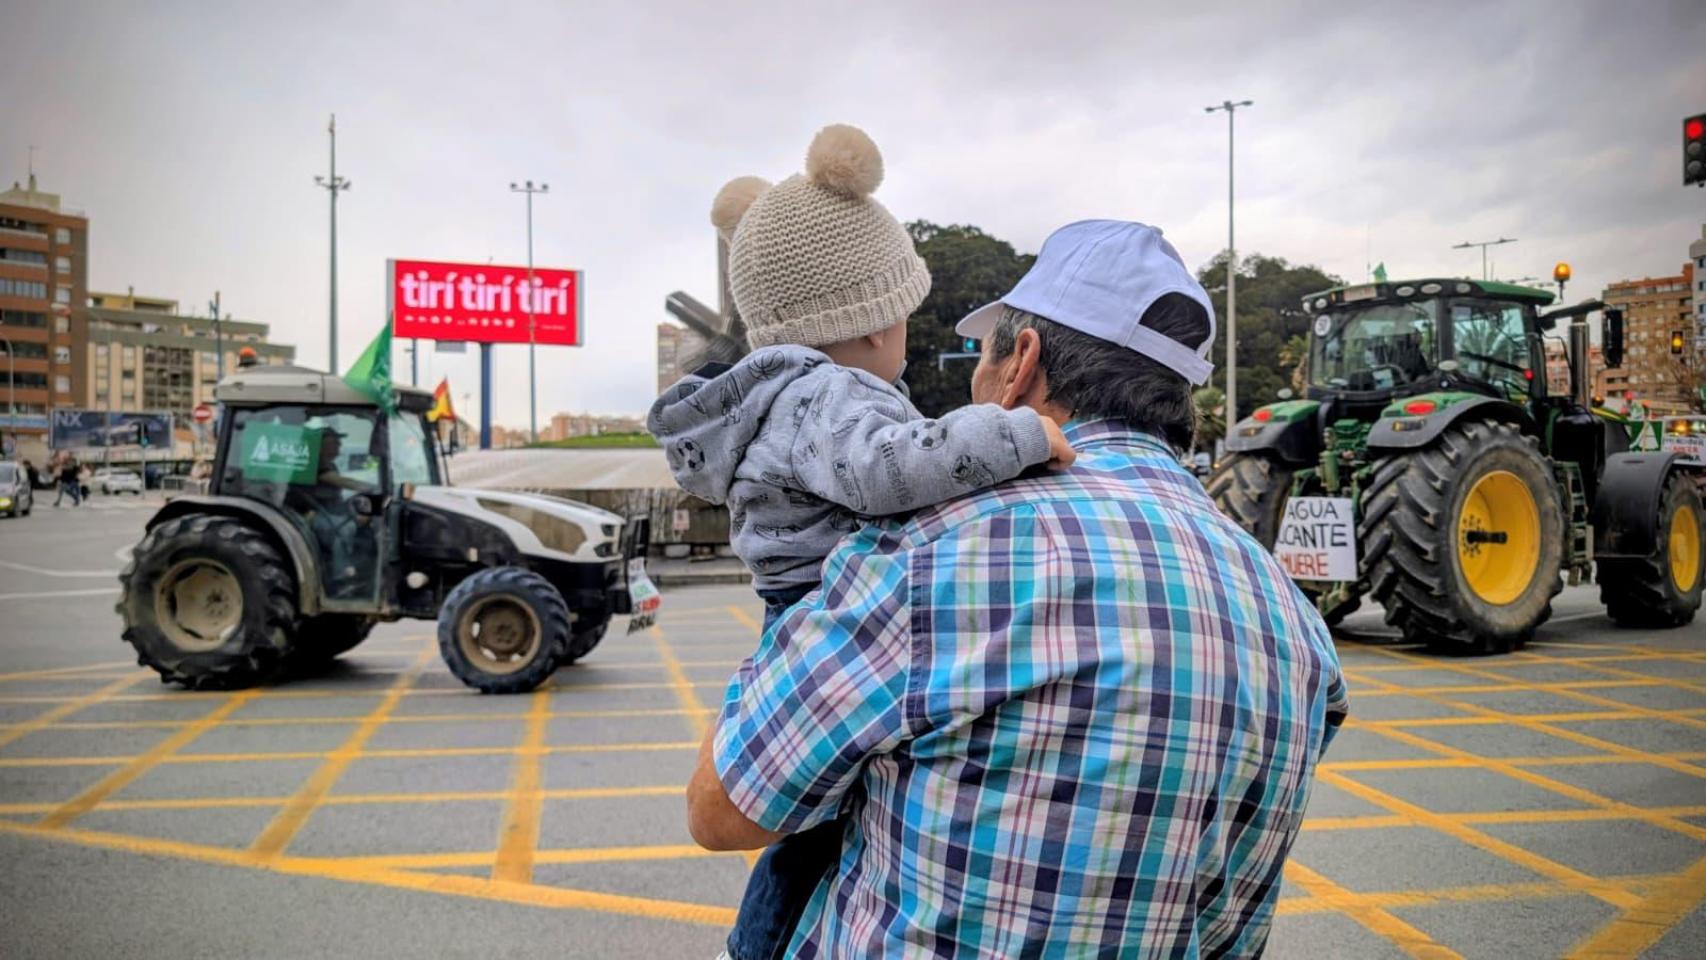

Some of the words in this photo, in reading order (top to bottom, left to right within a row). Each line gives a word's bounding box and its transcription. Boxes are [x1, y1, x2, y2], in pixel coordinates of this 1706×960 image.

[400, 270, 457, 309] tirí
[458, 273, 514, 312] tirí
[516, 277, 570, 315] tirí
[55, 412, 82, 427] NX
[271, 442, 310, 458] ASAJA
[1288, 500, 1339, 520] AGUA
